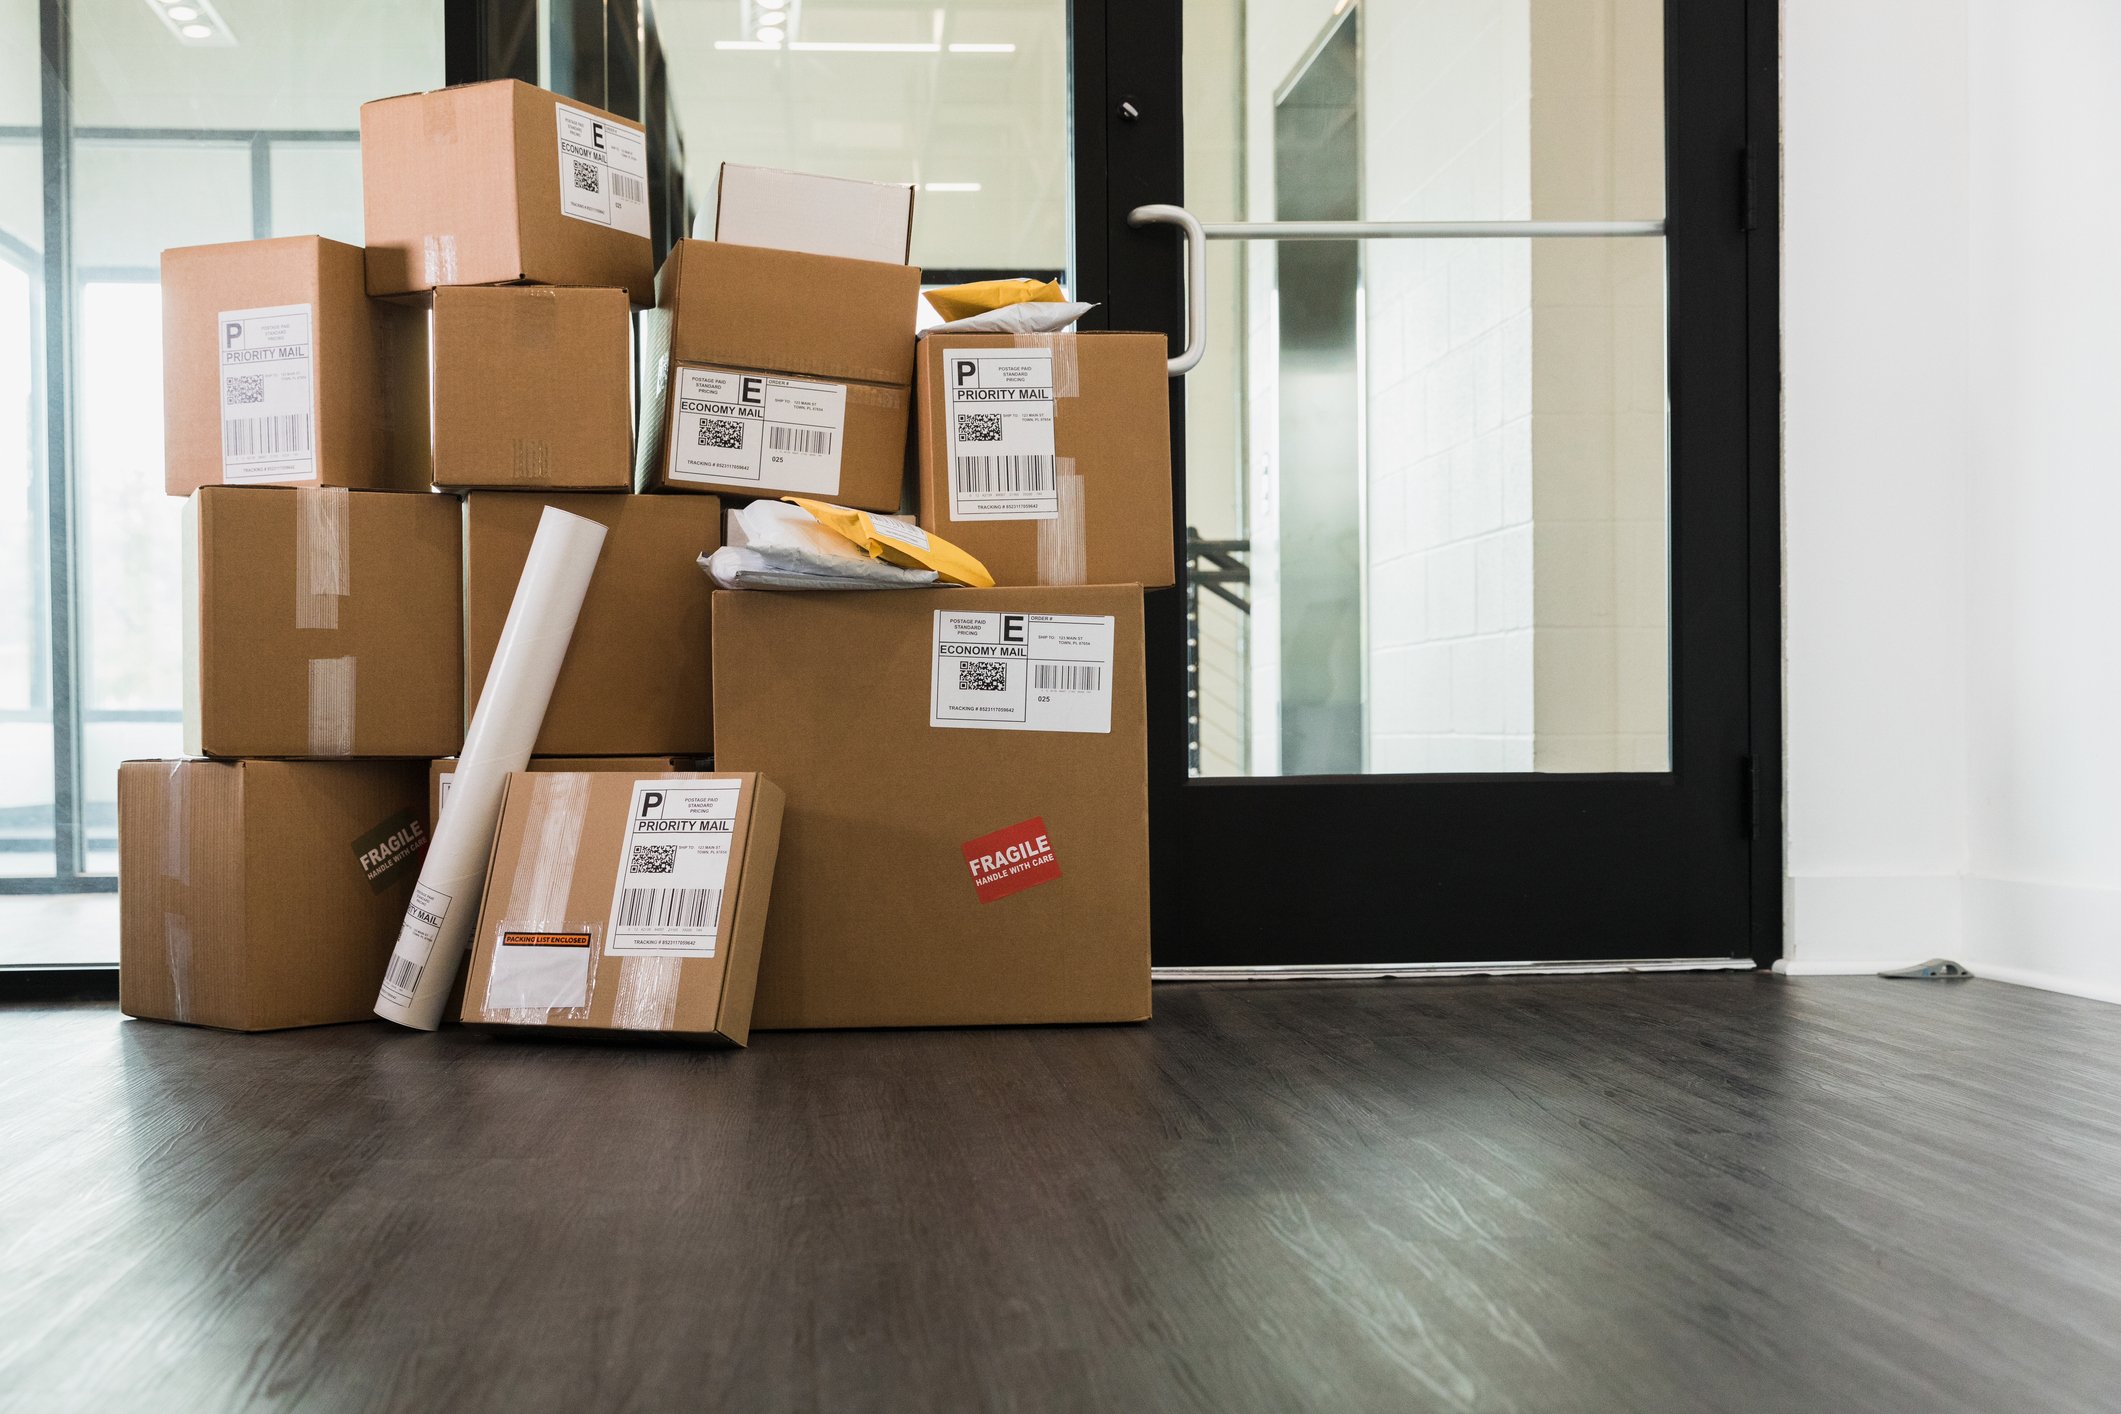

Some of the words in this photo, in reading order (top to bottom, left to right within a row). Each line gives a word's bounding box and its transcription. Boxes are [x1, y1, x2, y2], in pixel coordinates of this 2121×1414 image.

[593, 122, 604, 149] E
[562, 142, 592, 158] ECONOMY
[593, 152, 607, 164] MAIL
[226, 323, 242, 348] P
[226, 349, 276, 363] PRIORITY
[278, 347, 305, 358] MAIL
[957, 361, 976, 386] P
[742, 377, 763, 404] E
[957, 389, 1016, 400] PRIORITY
[1019, 389, 1049, 399] MAIL
[681, 401, 736, 416] ECONOMY
[738, 407, 763, 419] MAIL
[687, 459, 712, 467] TRACKING
[1003, 616, 1024, 641] E
[940, 645, 998, 656] ECONOMY
[1000, 647, 1027, 657] MAIL
[1037, 695, 1050, 703] 025
[641, 792, 663, 818] P
[638, 820, 697, 831] PRIORITY
[699, 820, 730, 831] MAIL
[360, 820, 423, 871] FRAGILE
[367, 859, 394, 880] HANDLE
[392, 848, 411, 863] WITH
[410, 836, 428, 851] CARE
[969, 835, 1051, 876] FRAGILE
[975, 869, 1008, 887] HANDLE
[1009, 862, 1031, 875] WITH
[1032, 853, 1054, 867] CARE
[417, 910, 438, 926] MAIL
